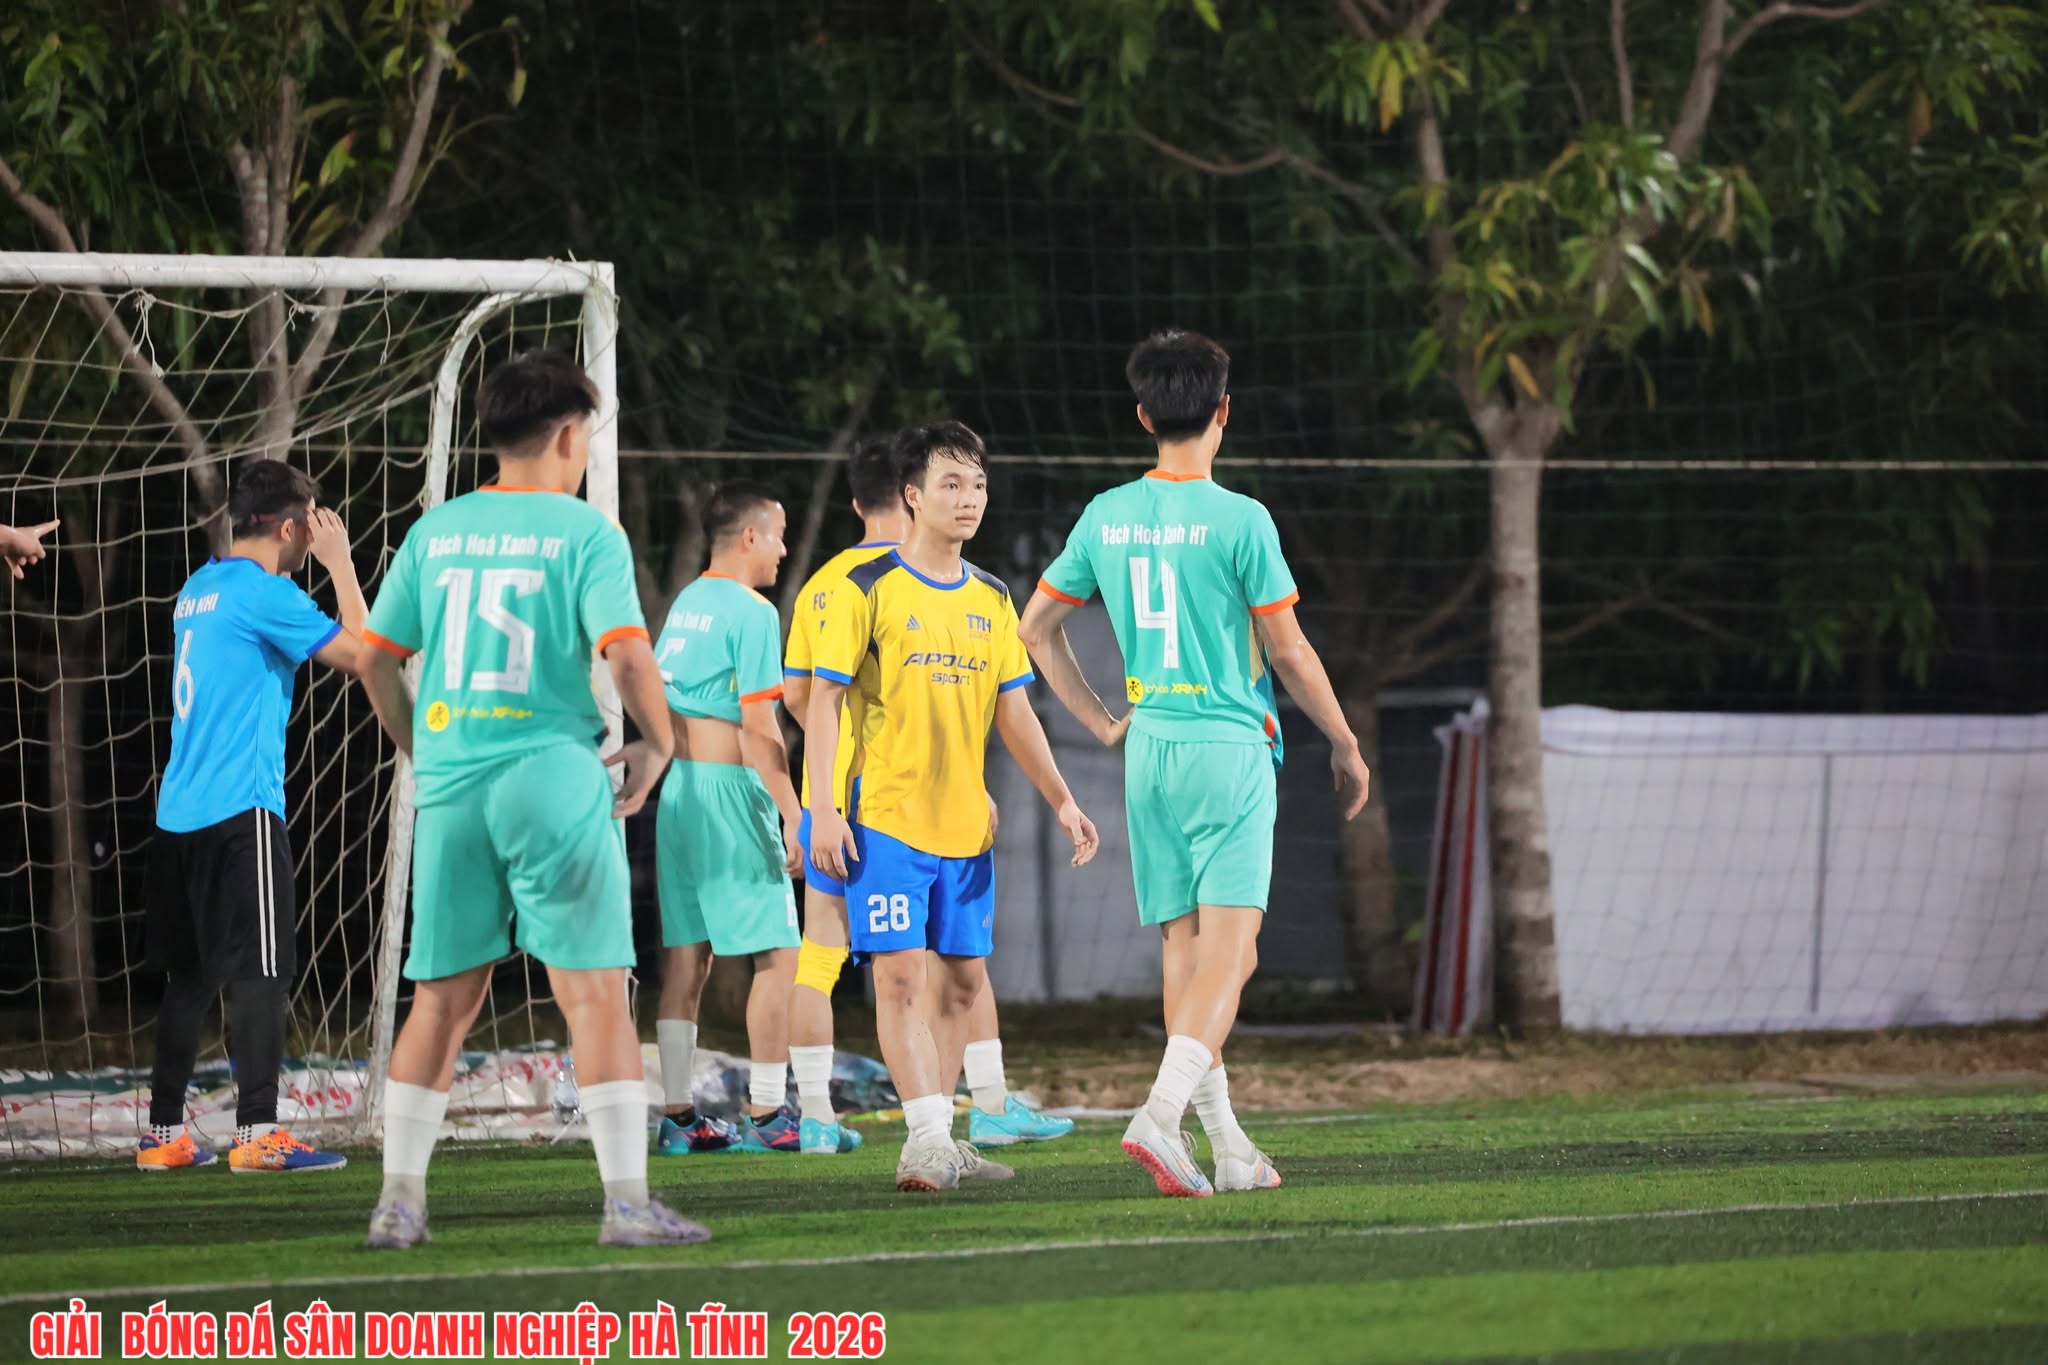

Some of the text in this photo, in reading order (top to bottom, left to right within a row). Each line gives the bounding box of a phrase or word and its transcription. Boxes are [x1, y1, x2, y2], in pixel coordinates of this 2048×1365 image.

[540, 537, 564, 559] HT
[1102, 524, 1129, 545] Bách
[1133, 524, 1160, 545] Hoá
[1189, 525, 1208, 545] HT
[434, 567, 545, 694] 15
[966, 613, 991, 633] TTH
[1128, 556, 1180, 669] 4
[174, 629, 194, 722] 6
[867, 893, 911, 933] 28
